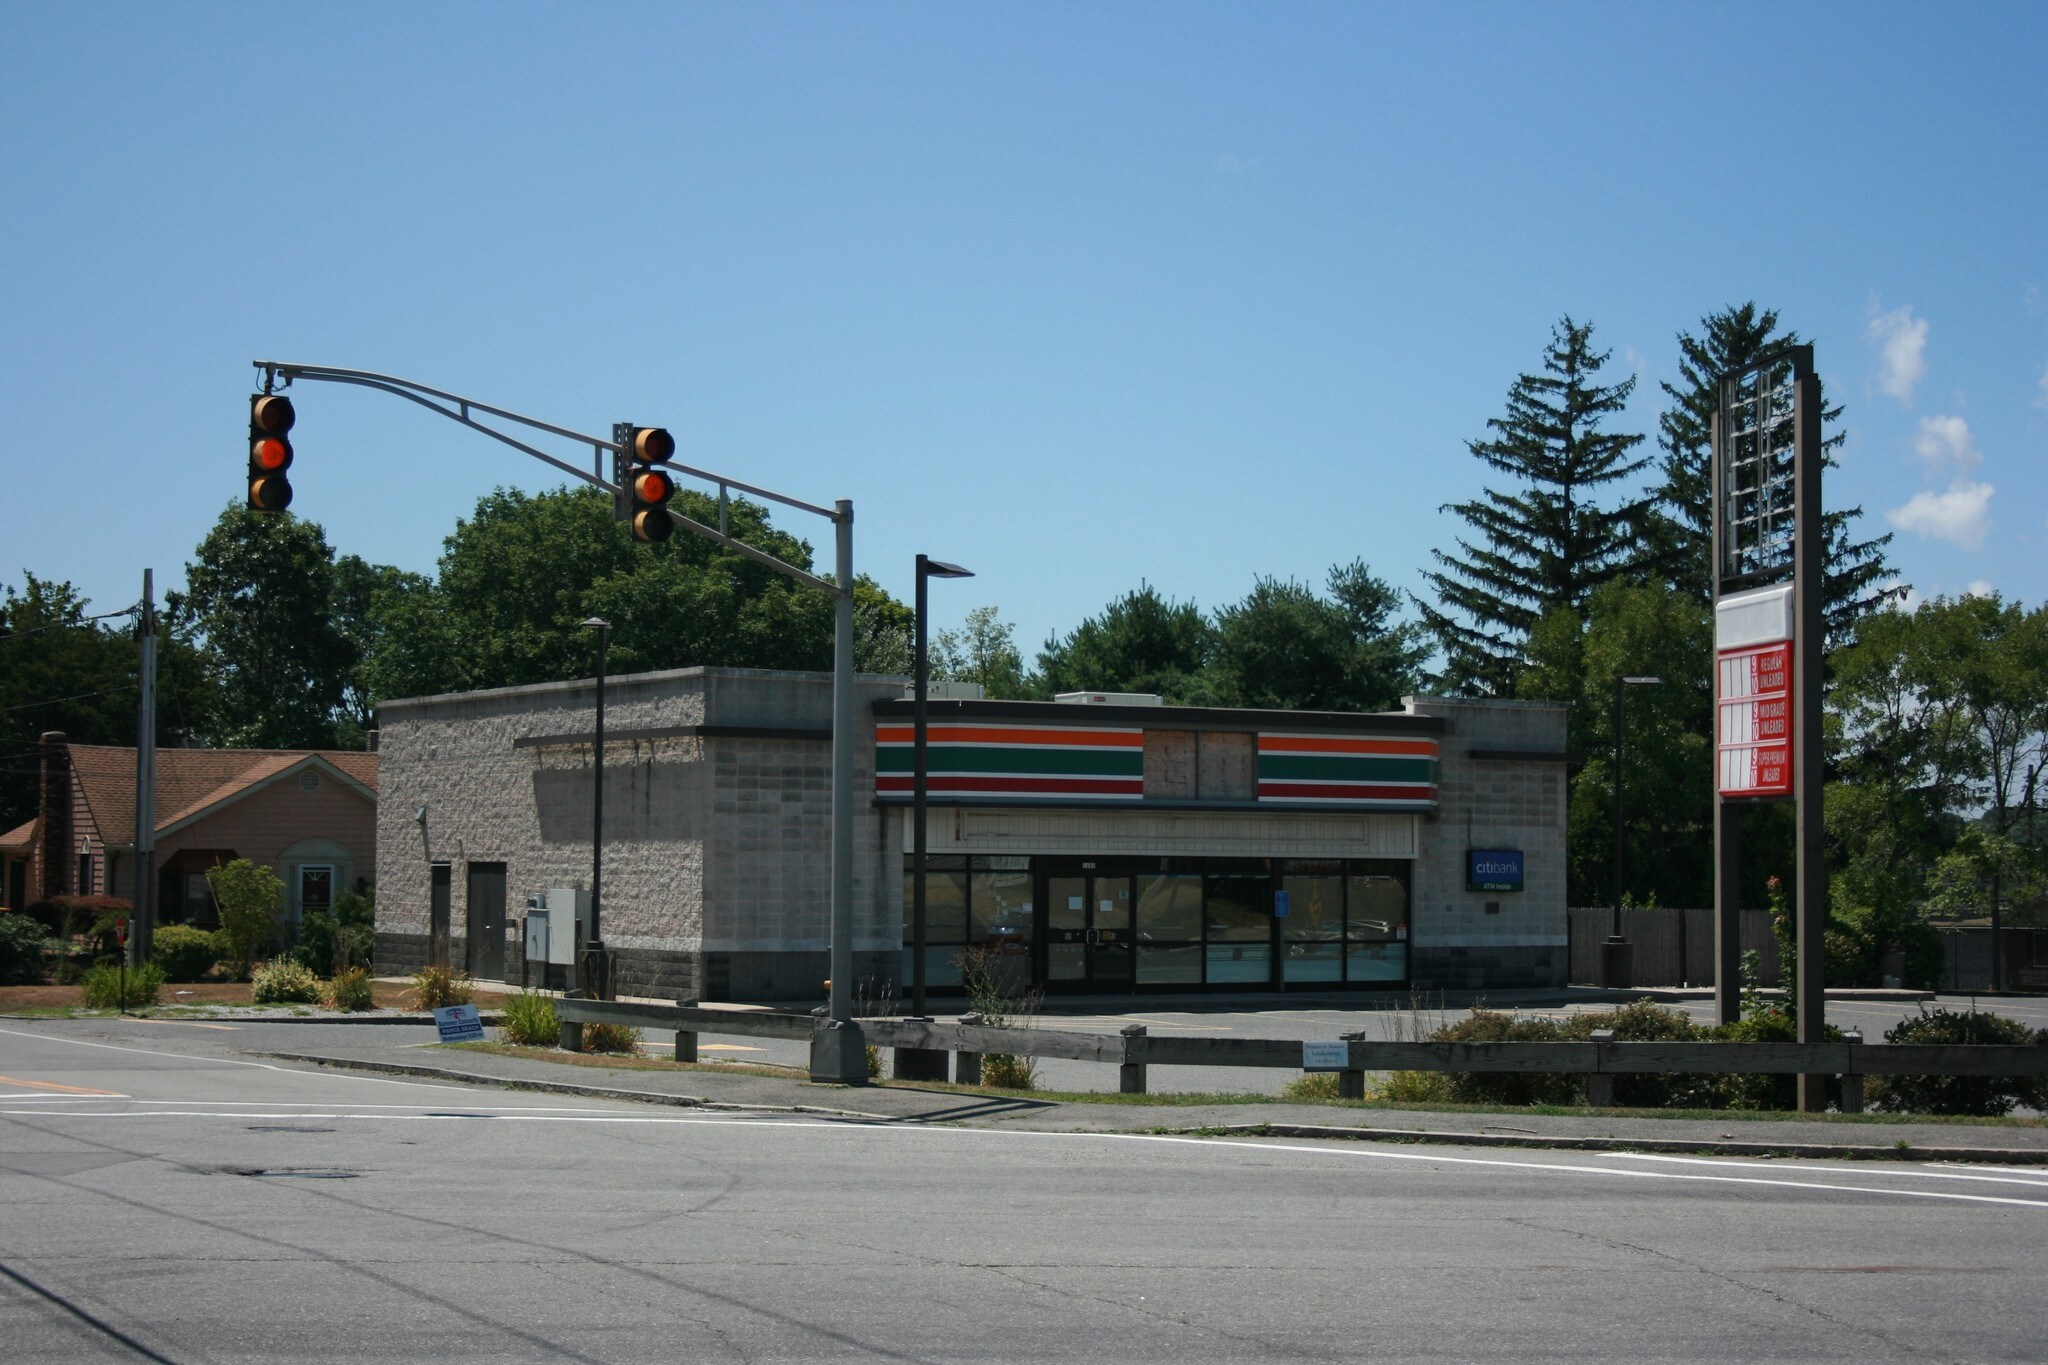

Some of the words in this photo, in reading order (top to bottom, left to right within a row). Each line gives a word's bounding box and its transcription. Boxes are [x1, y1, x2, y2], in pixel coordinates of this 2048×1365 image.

[1751, 655, 1757, 672] 9
[1760, 655, 1783, 671] REGULAR
[1751, 676, 1759, 694] 10
[1760, 671, 1784, 688] UNLEADED
[1753, 702, 1758, 719] 9
[1760, 704, 1769, 719] MID
[1770, 701, 1784, 718] GRADE
[1752, 723, 1759, 740] 10
[1760, 718, 1784, 735] UNLEADED
[1752, 748, 1758, 765] 9
[1751, 769, 1758, 787] 10
[1762, 767, 1780, 782] UNLEADED
[1476, 861, 1518, 874] citibank
